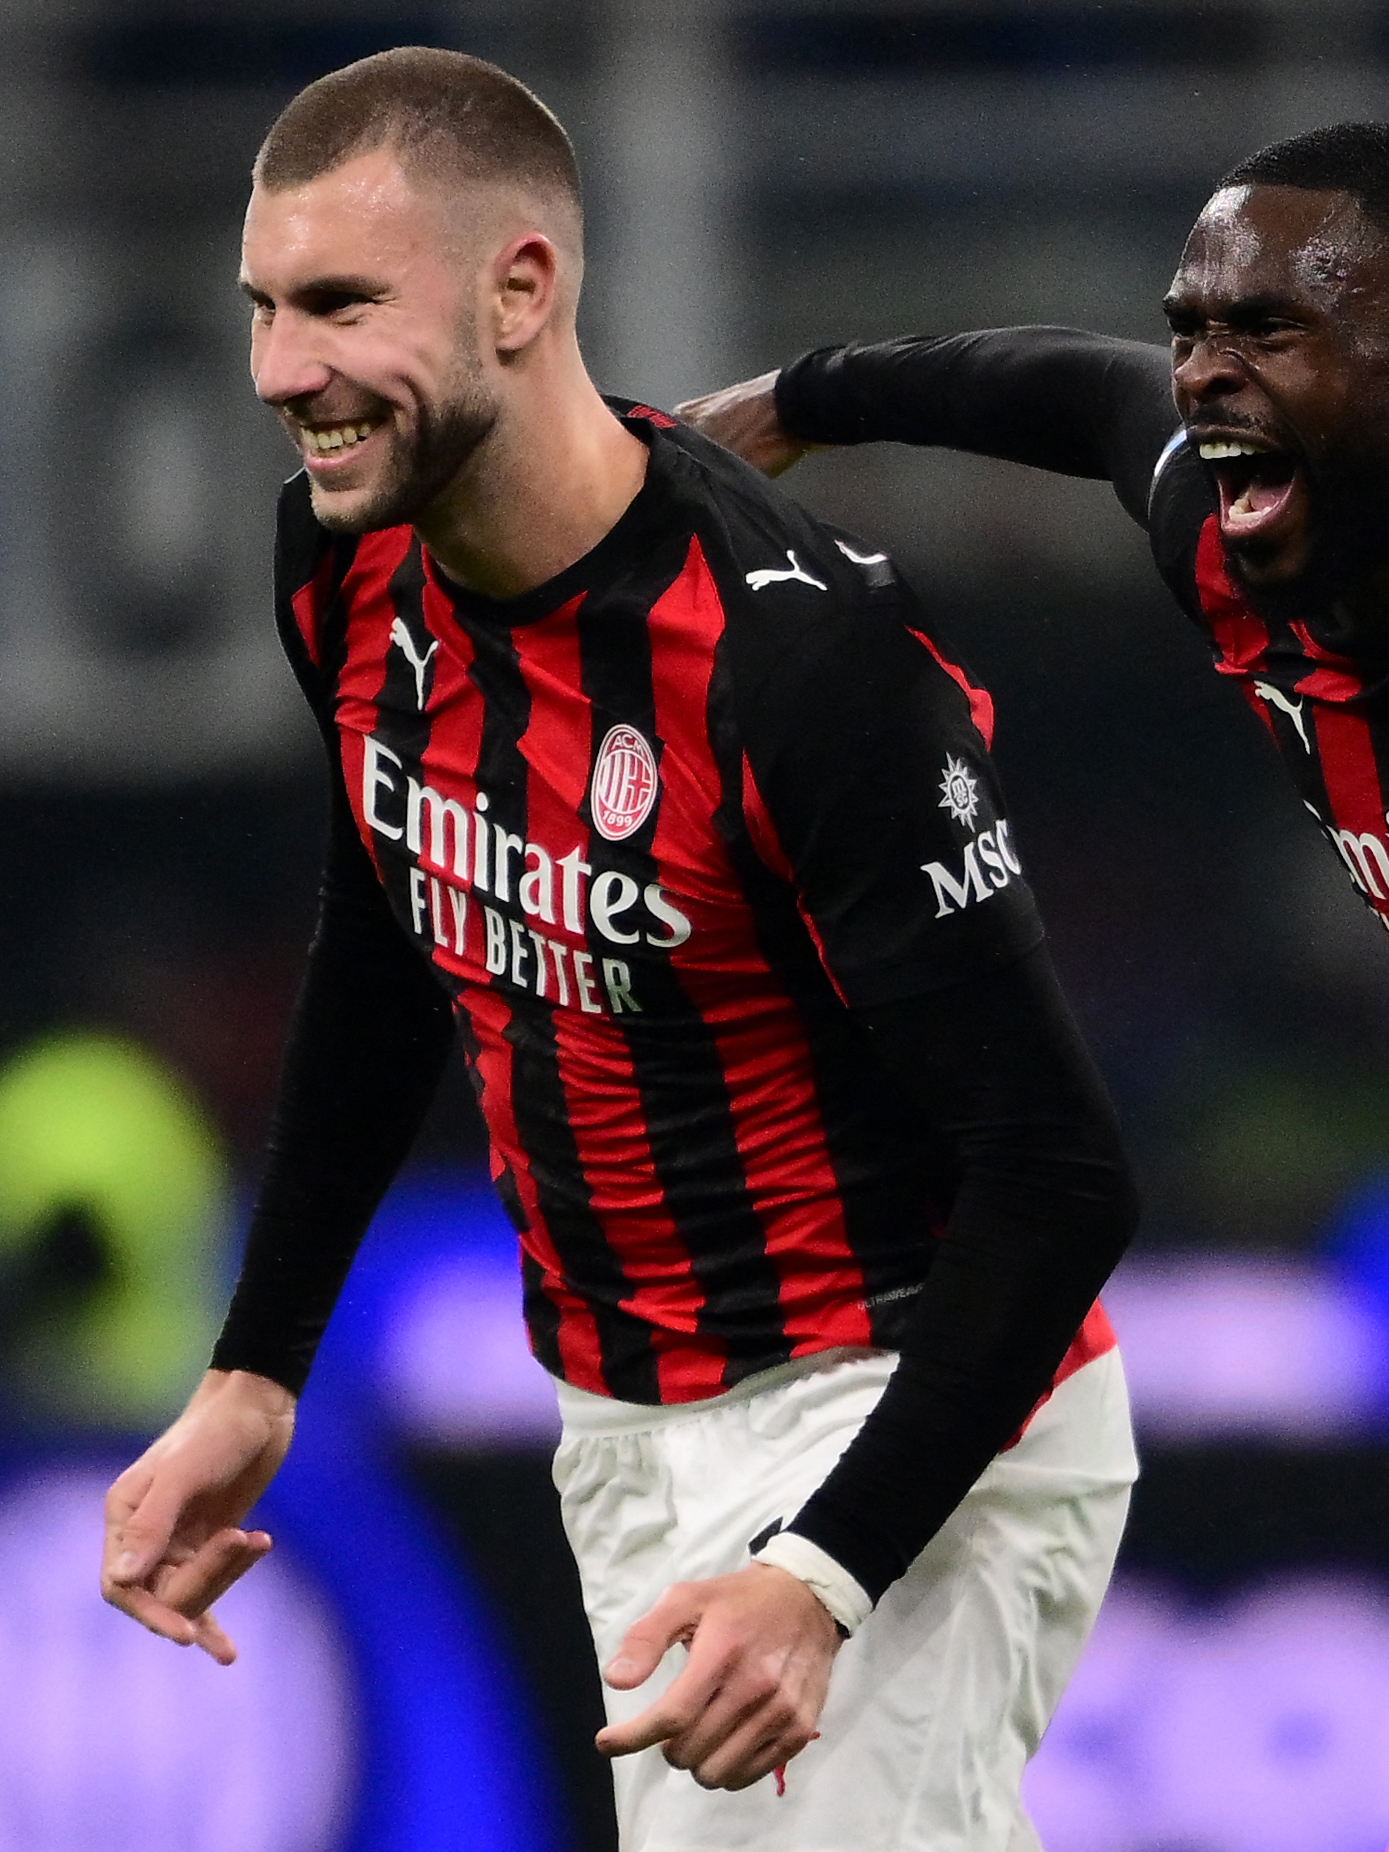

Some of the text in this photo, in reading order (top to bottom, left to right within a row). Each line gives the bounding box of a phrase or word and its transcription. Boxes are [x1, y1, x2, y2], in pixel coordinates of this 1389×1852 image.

[611, 733, 647, 759] ACM
[362, 733, 692, 948] Emirates
[602, 810, 633, 827] 1899
[920, 818, 1022, 919] MSC
[408, 867, 644, 1014] FLY BETTER
